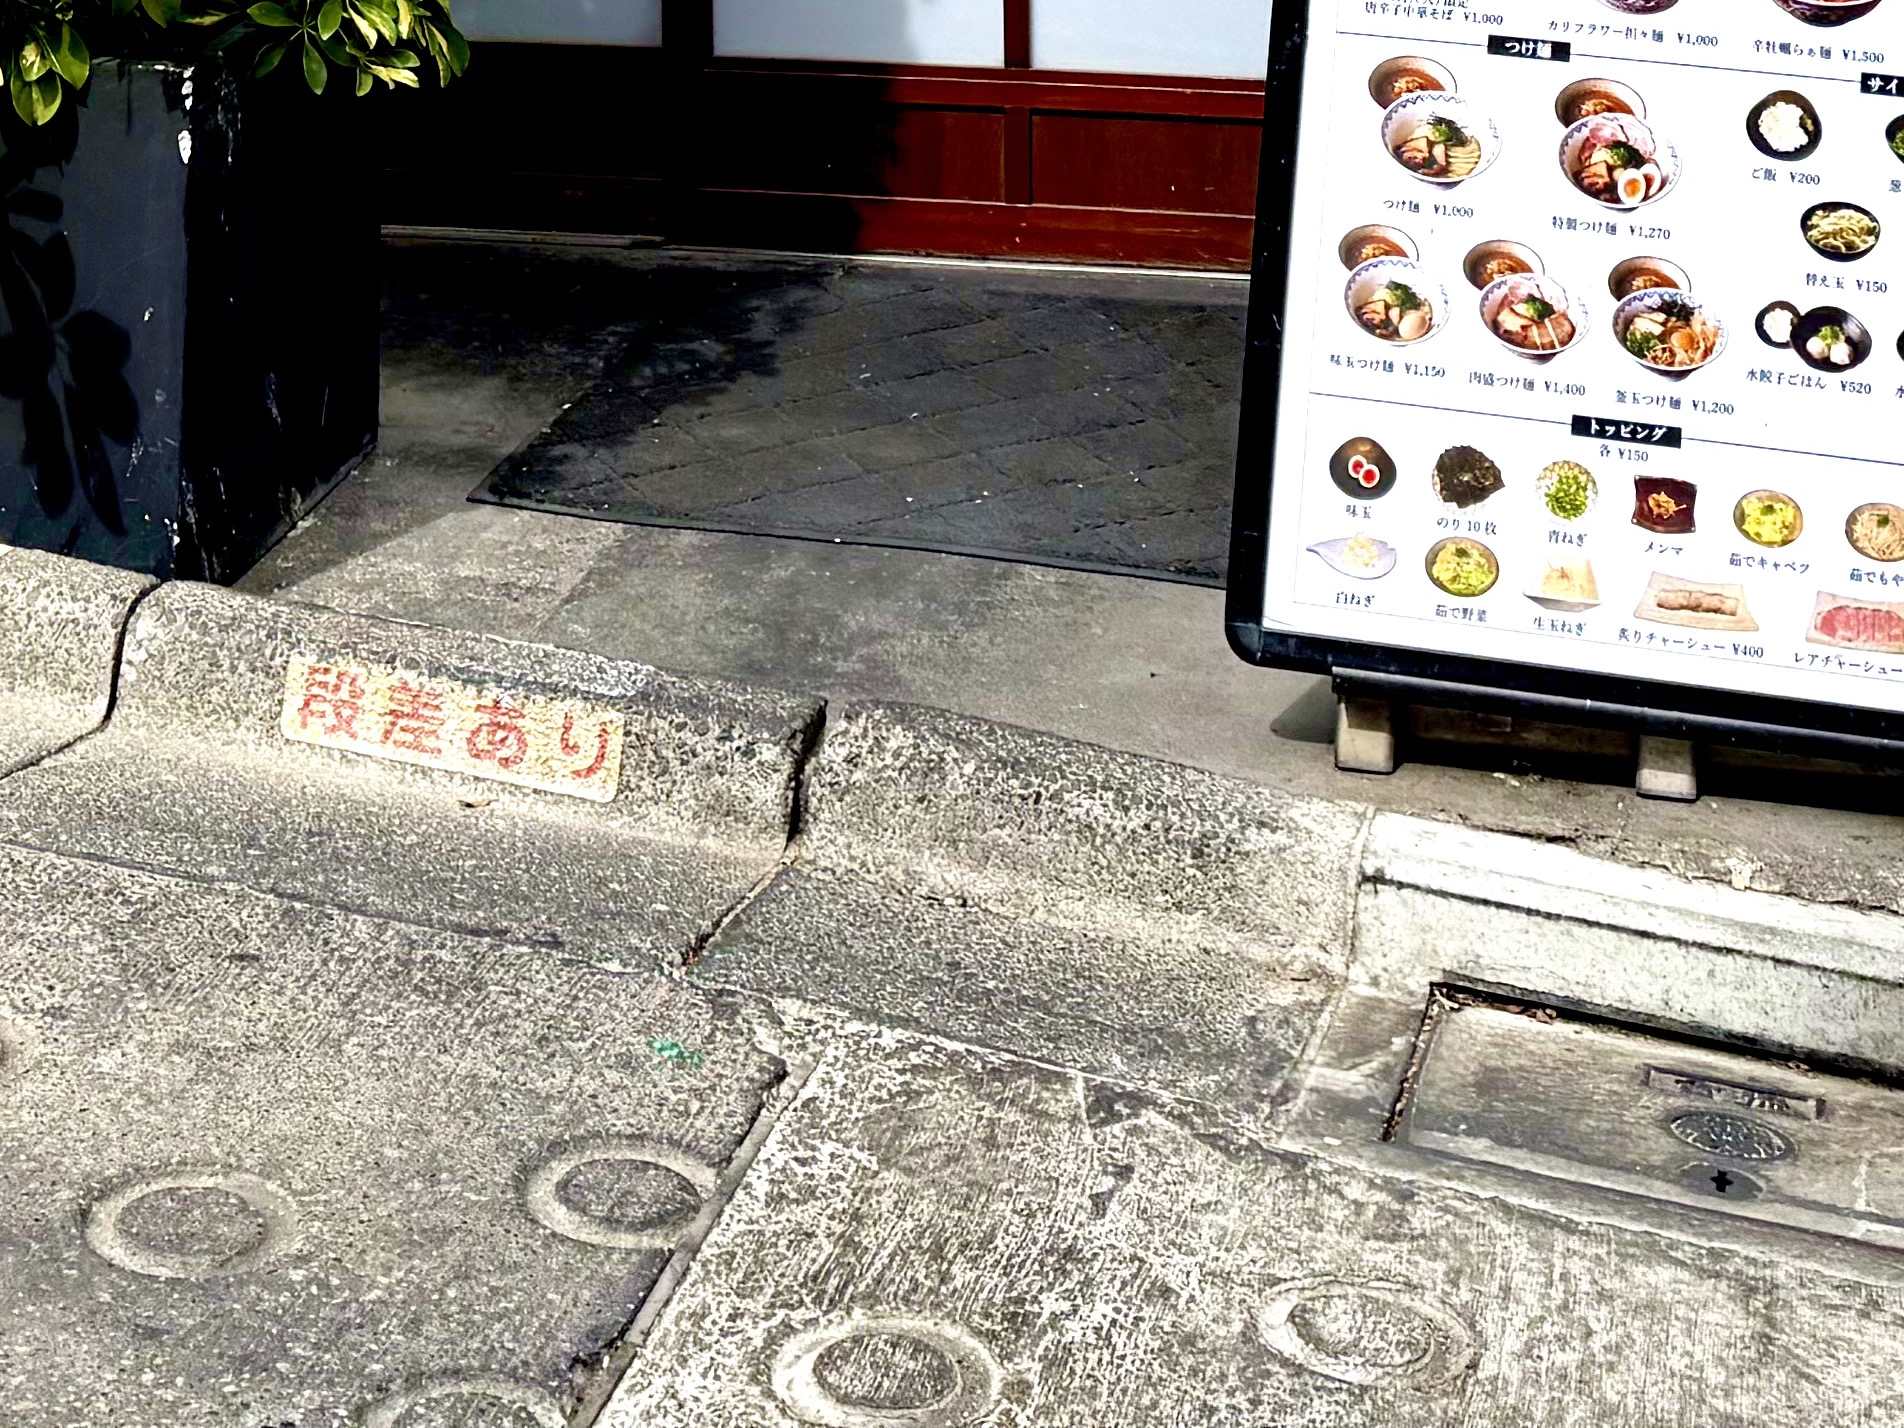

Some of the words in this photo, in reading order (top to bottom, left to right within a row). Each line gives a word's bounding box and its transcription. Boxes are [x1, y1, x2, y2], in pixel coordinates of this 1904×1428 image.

[1591, 419, 1667, 441] トッピング
[298, 664, 610, 780] 段差あり
